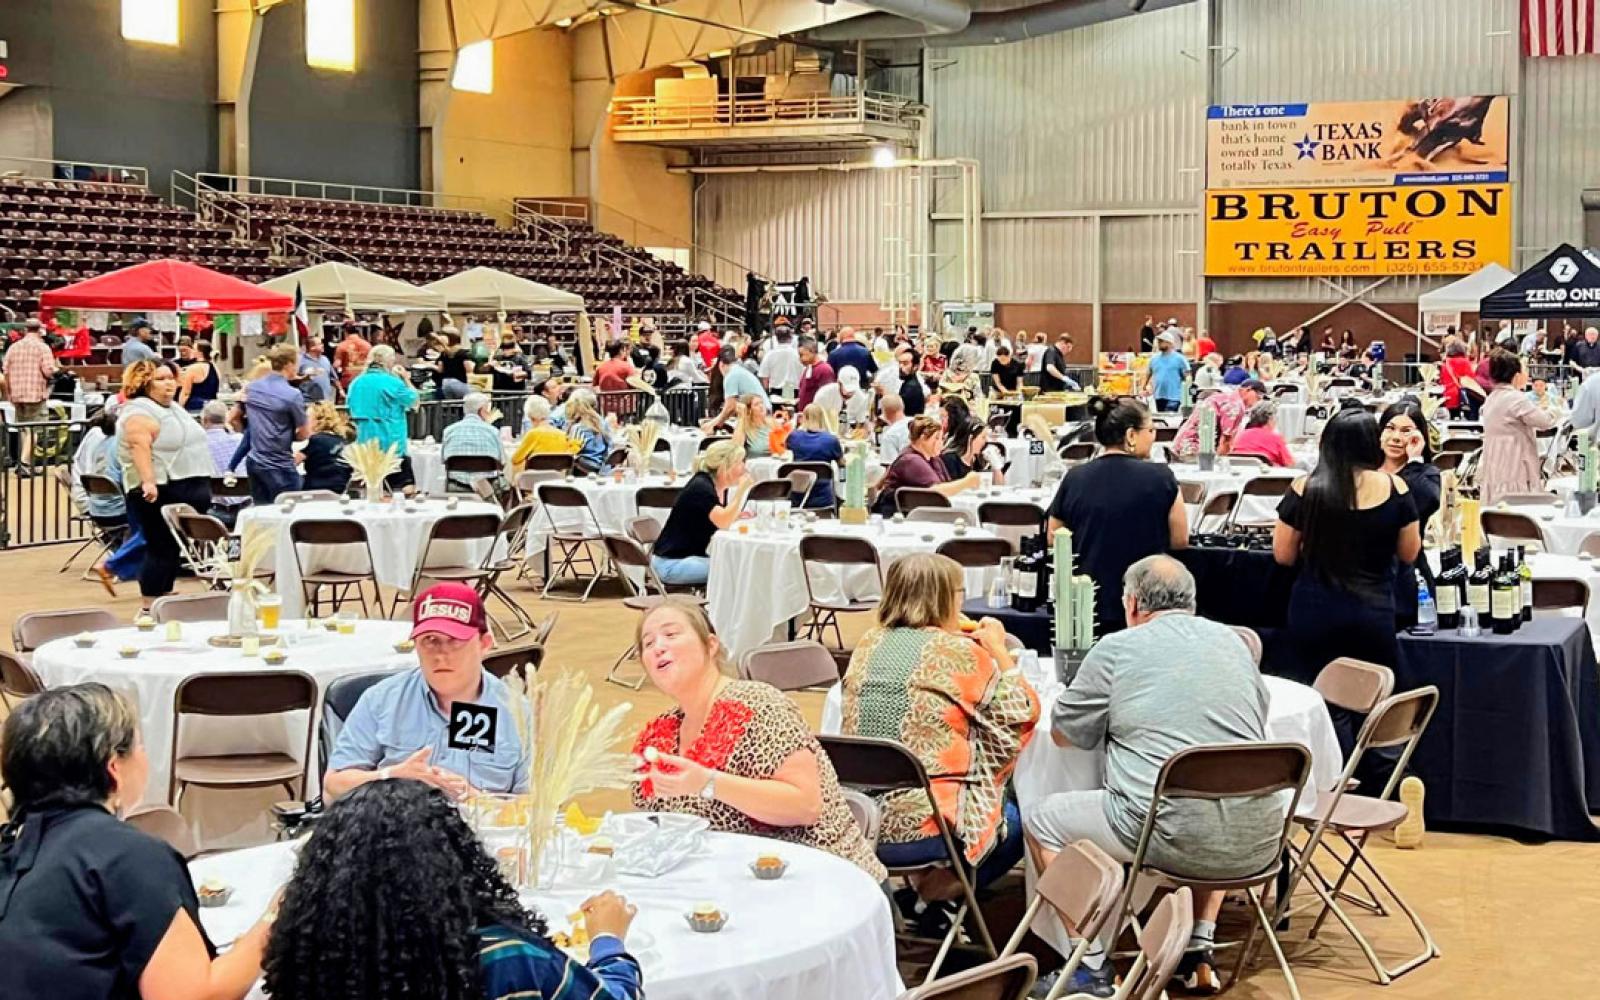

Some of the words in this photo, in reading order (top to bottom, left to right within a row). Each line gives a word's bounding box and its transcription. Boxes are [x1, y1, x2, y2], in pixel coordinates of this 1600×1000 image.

[1221, 105, 1260, 116] There's
[1262, 106, 1286, 116] one
[1221, 119, 1249, 131] bank
[1253, 119, 1265, 131] in
[1268, 119, 1297, 130] town
[1313, 122, 1382, 140] TEXAS
[1221, 133, 1251, 145] that's
[1253, 132, 1286, 144] home
[1221, 146, 1259, 158] owned
[1262, 145, 1284, 157] and
[1322, 142, 1382, 160] BANK
[1221, 160, 1257, 173] totally
[1211, 189, 1503, 220] BRUTON
[1290, 221, 1342, 241] Easy
[1365, 220, 1414, 237] Pull
[1234, 239, 1477, 261] TRAILERS
[1386, 262, 1419, 274] (325)
[1559, 264, 1570, 276] Z
[1570, 288, 1600, 301] ONE
[420, 595, 470, 622] JESUS
[454, 710, 491, 746] 22
